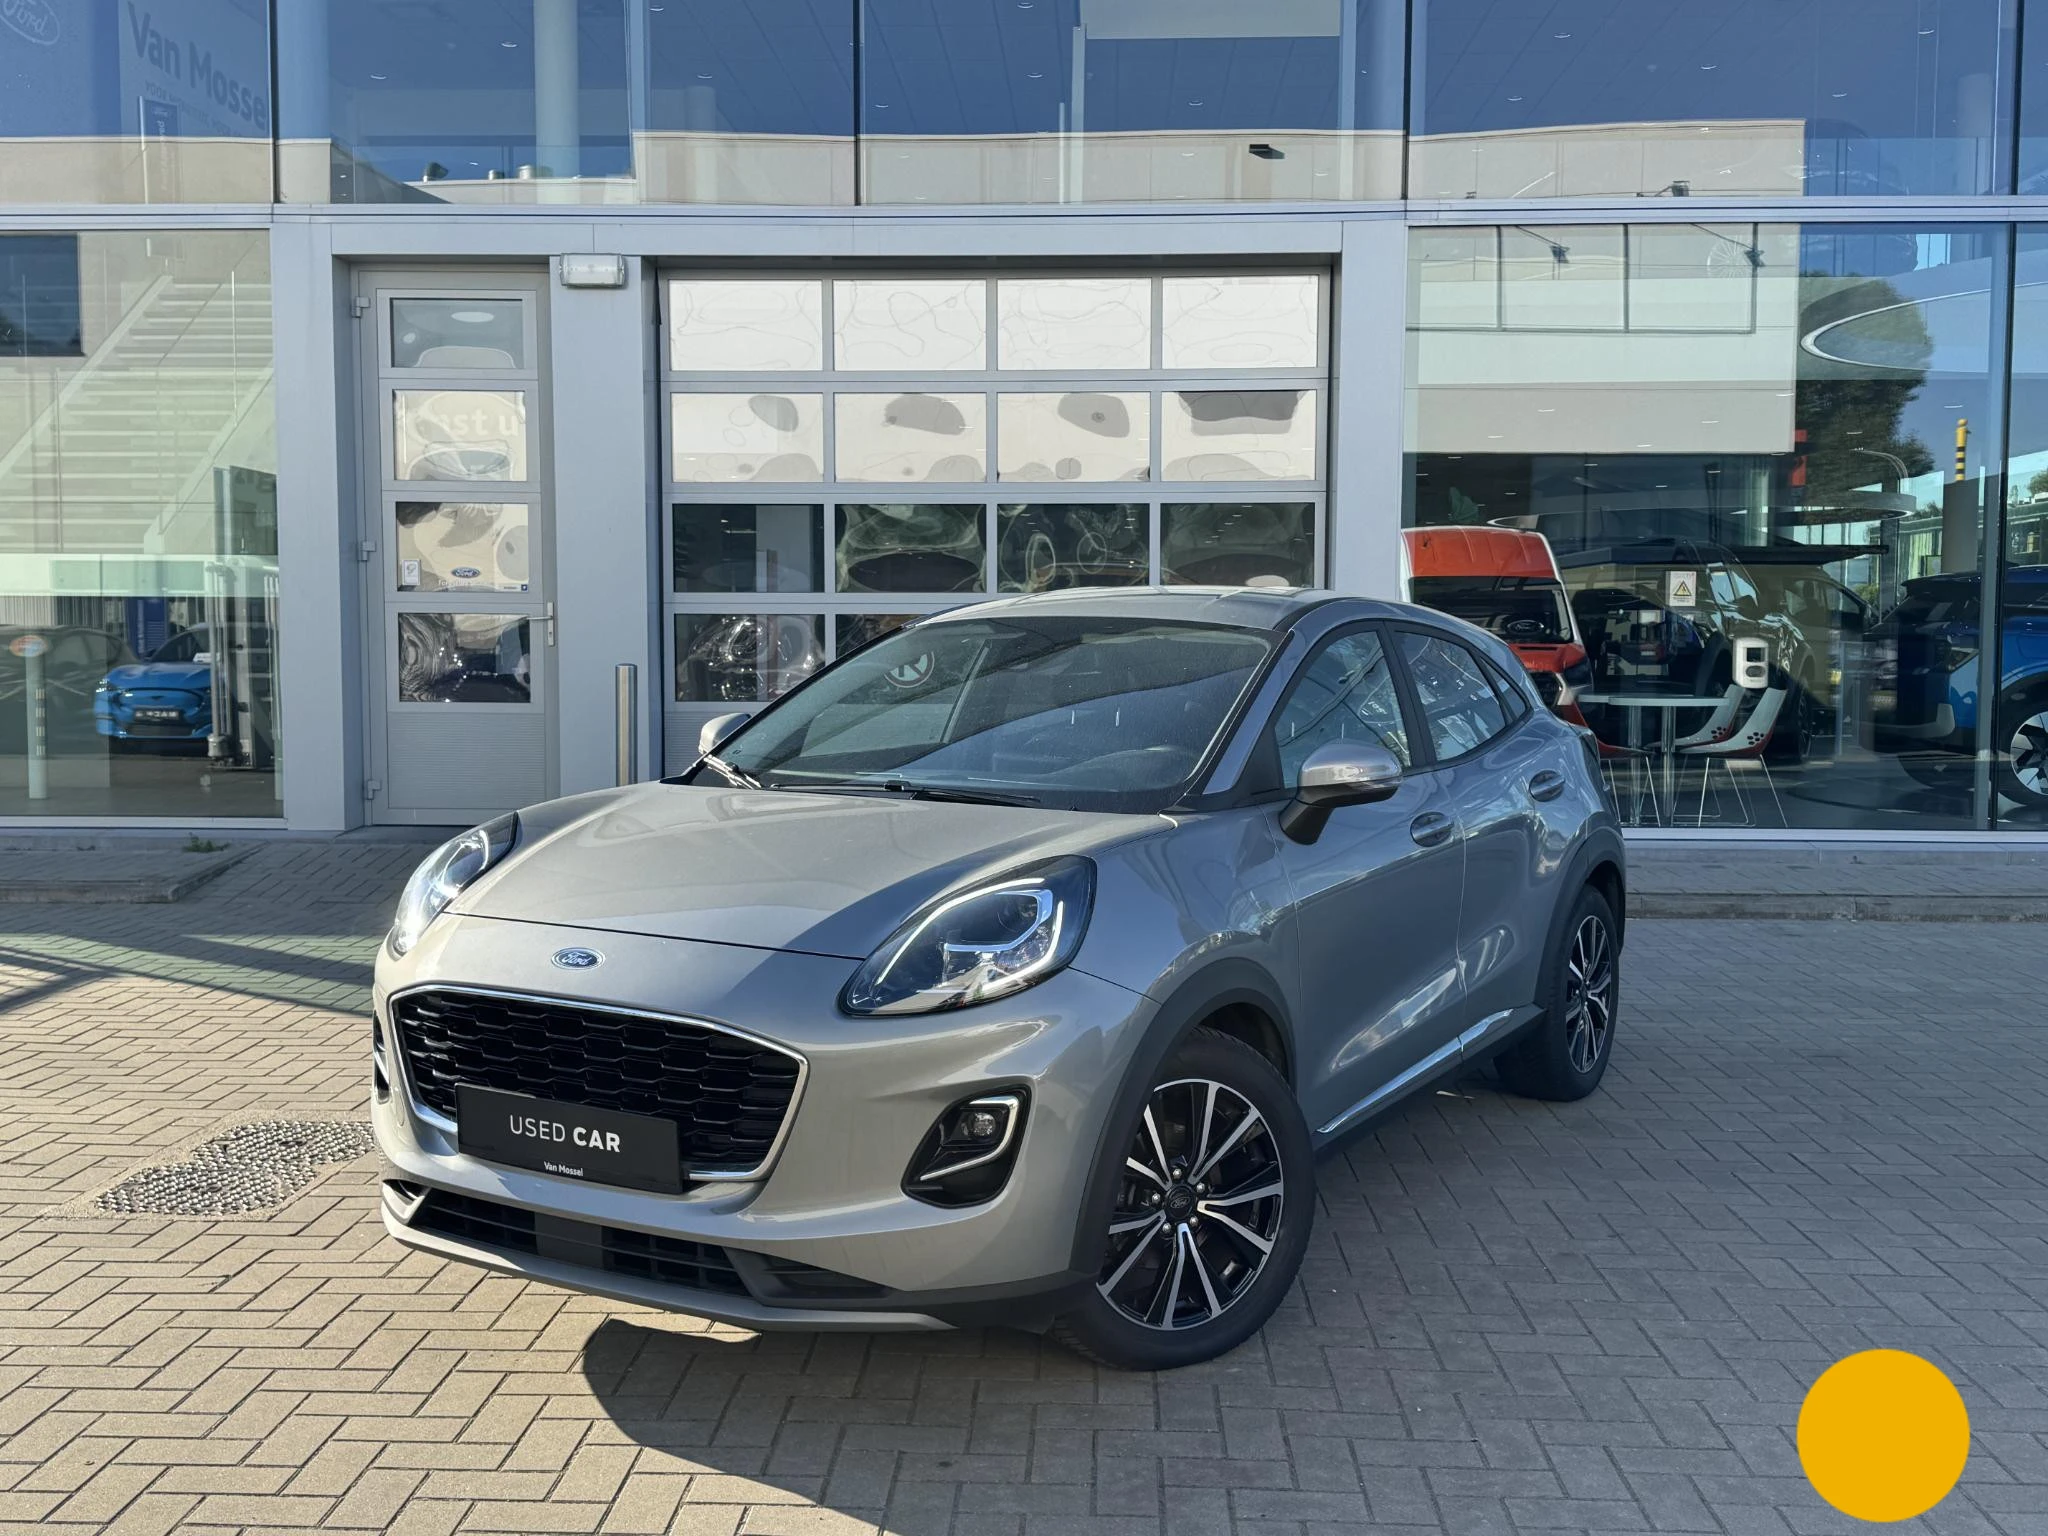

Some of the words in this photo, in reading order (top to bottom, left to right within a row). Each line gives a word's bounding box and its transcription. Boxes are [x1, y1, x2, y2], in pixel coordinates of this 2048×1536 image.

[128, 1, 181, 80] Van
[189, 41, 267, 132] Mosse
[509, 1114, 566, 1142] USED
[572, 1126, 621, 1153] CAR
[544, 1161, 558, 1173] Van
[558, 1164, 584, 1177] Mossel
